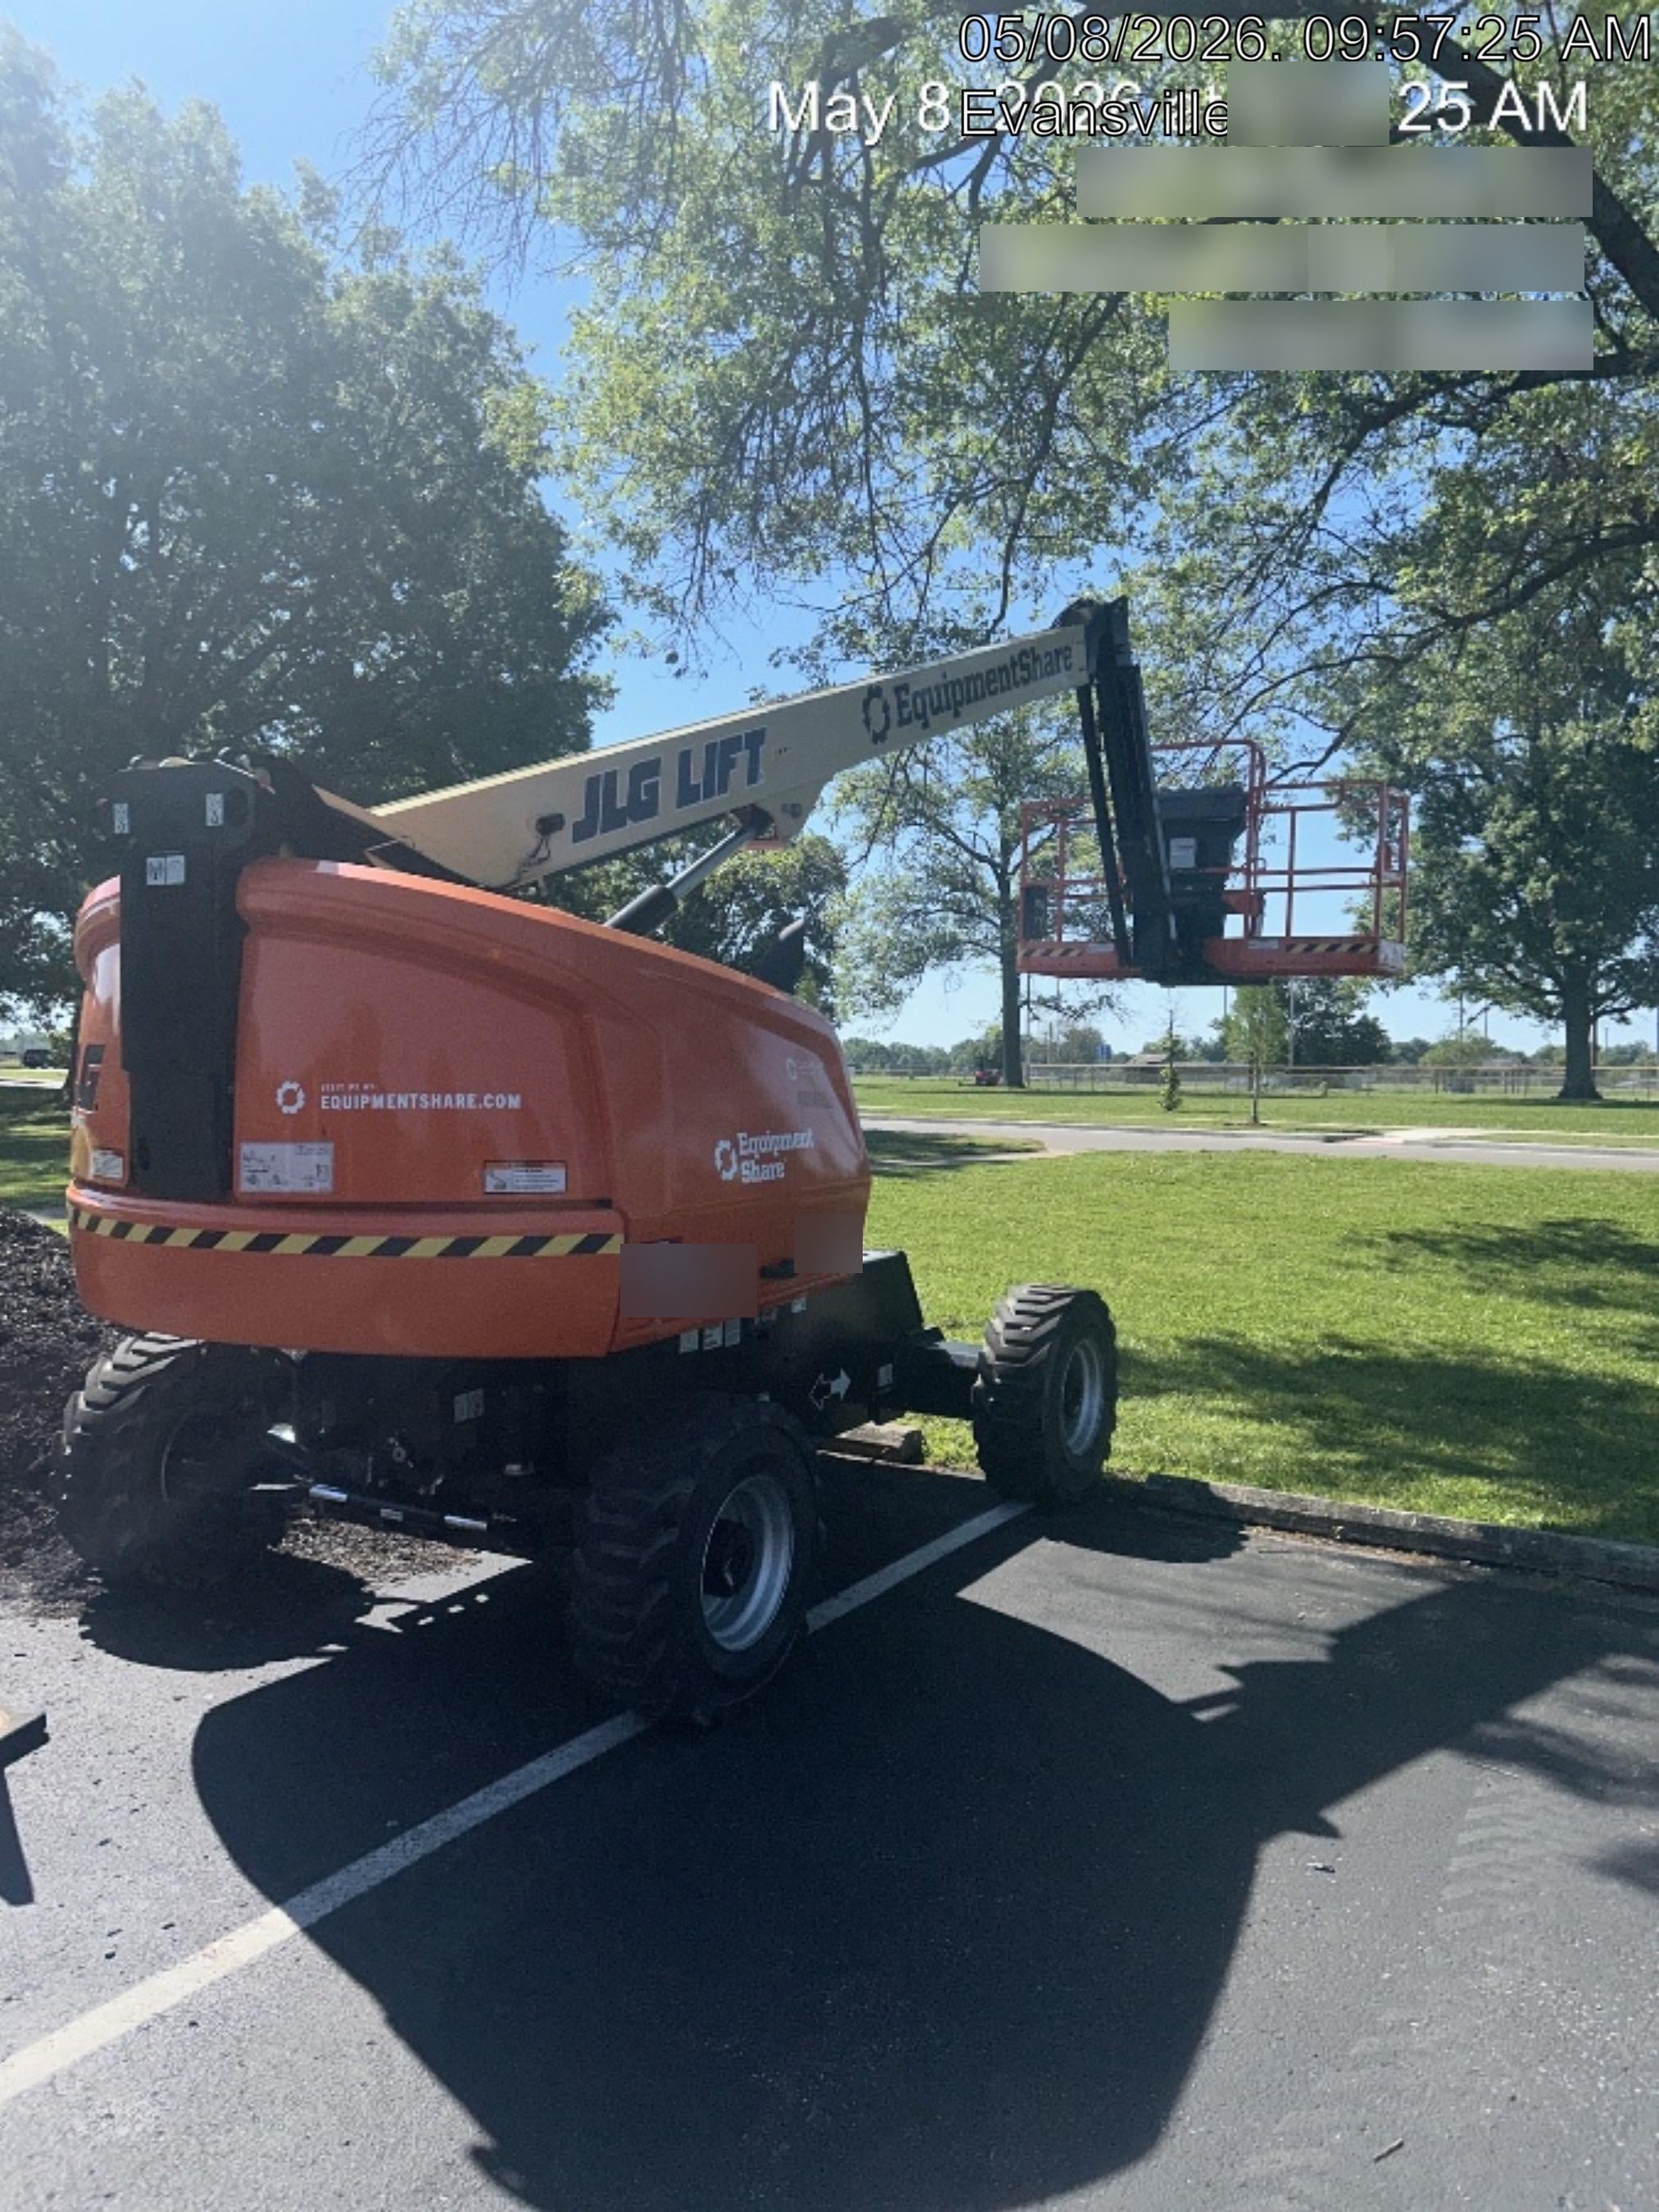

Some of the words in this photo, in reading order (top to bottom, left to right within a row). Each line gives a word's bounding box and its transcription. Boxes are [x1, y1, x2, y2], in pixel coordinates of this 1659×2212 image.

[894, 646, 1072, 730] EquipmentShare
[572, 757, 662, 844] JLG
[676, 728, 767, 809] LIFT
[320, 1093, 522, 1111] EQUIPMENTSHARE.COM
[737, 1128, 814, 1157] Equipment
[741, 1160, 786, 1183] Share
